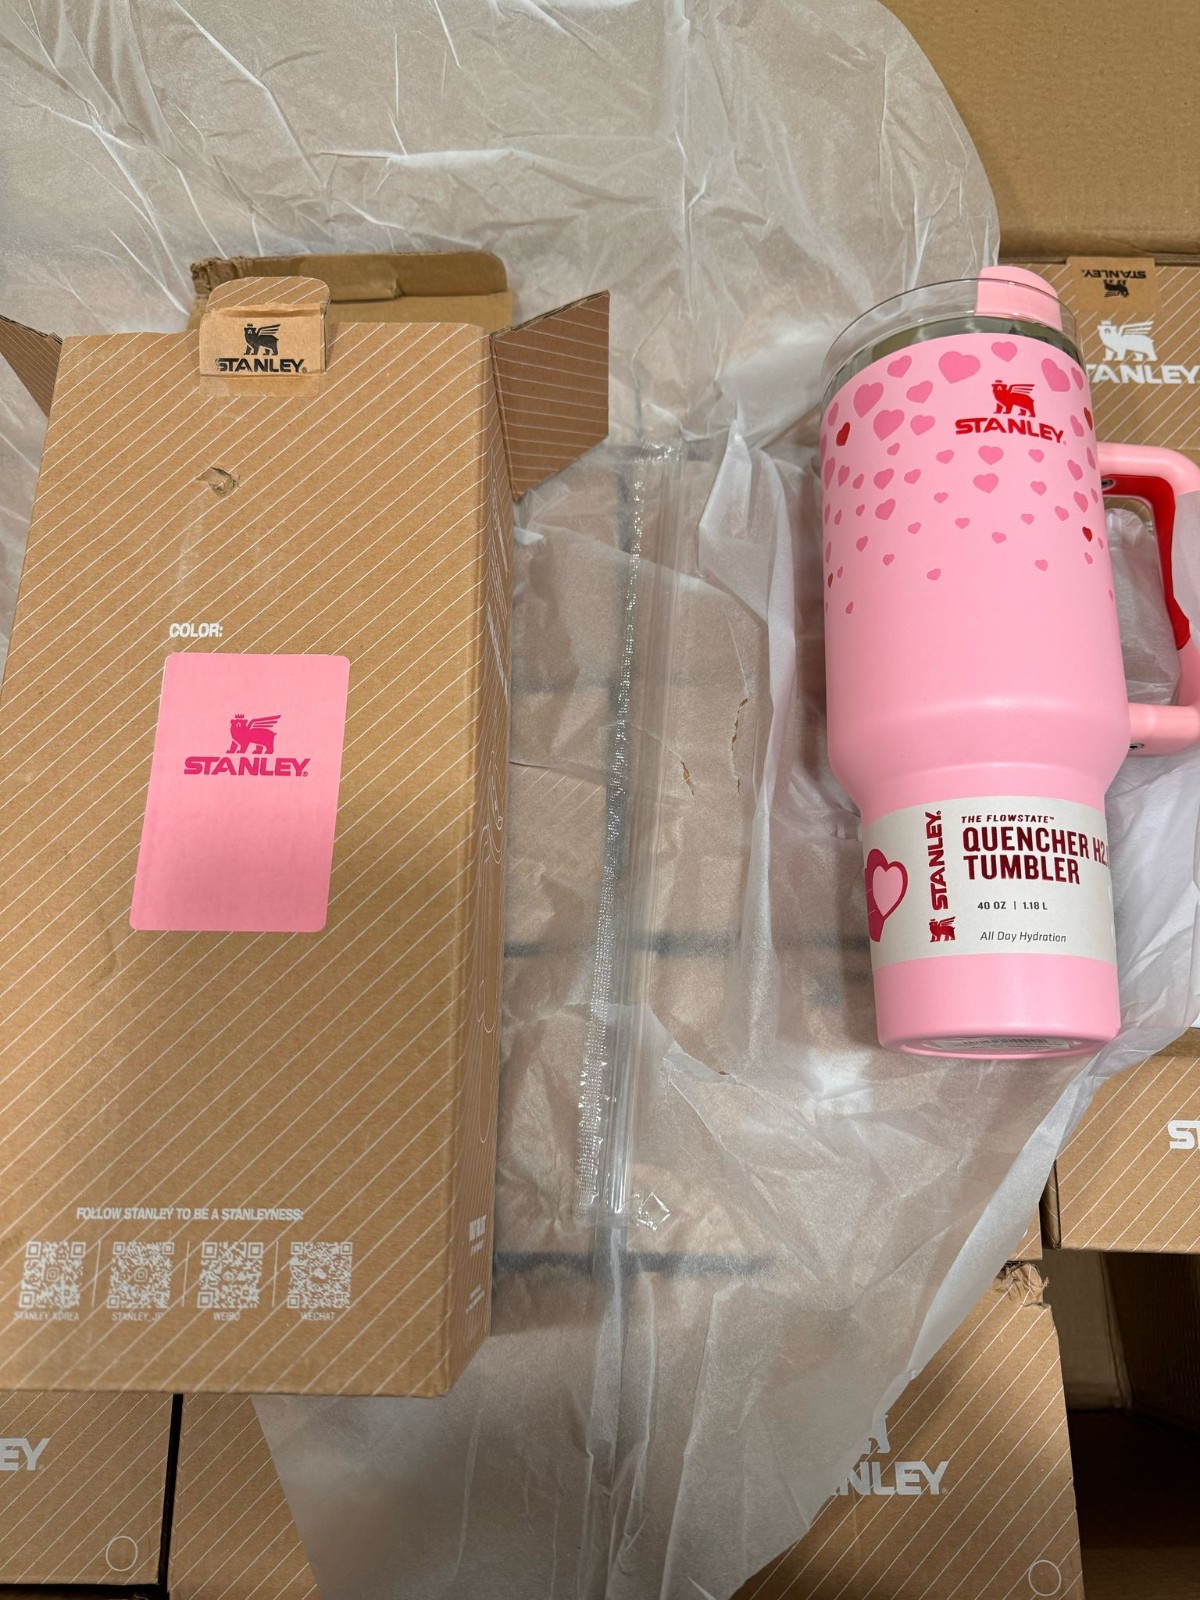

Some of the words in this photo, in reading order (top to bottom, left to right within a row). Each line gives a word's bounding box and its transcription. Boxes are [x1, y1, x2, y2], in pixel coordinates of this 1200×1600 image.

[1082, 269, 1146, 279] STANLEY
[1085, 364, 1200, 384] TANLEY
[955, 417, 1064, 444] STANLEY
[169, 622, 223, 638] COLOR:
[184, 756, 311, 777] STANLEY
[961, 815, 982, 824] THE
[963, 826, 1089, 859] QUENCHER
[925, 810, 949, 911] STANLEY
[963, 854, 1080, 885] TUMBLER
[977, 901, 991, 910] 40
[993, 901, 1007, 910] OZ
[1022, 901, 1040, 910] 1.18
[1042, 902, 1048, 910] L
[980, 931, 994, 941] All
[997, 931, 1017, 943] Day
[1019, 931, 1067, 943] Hydration
[76, 1207, 121, 1220] FOLLOW
[124, 1207, 174, 1220] STANLEY
[176, 1207, 191, 1220] TO
[194, 1208, 209, 1220] BE
[211, 1208, 219, 1220] A
[221, 1208, 304, 1221] STANLEYNESS:
[301, 1311, 336, 1322] WECHAT
[832, 1460, 950, 1496] NLEY
